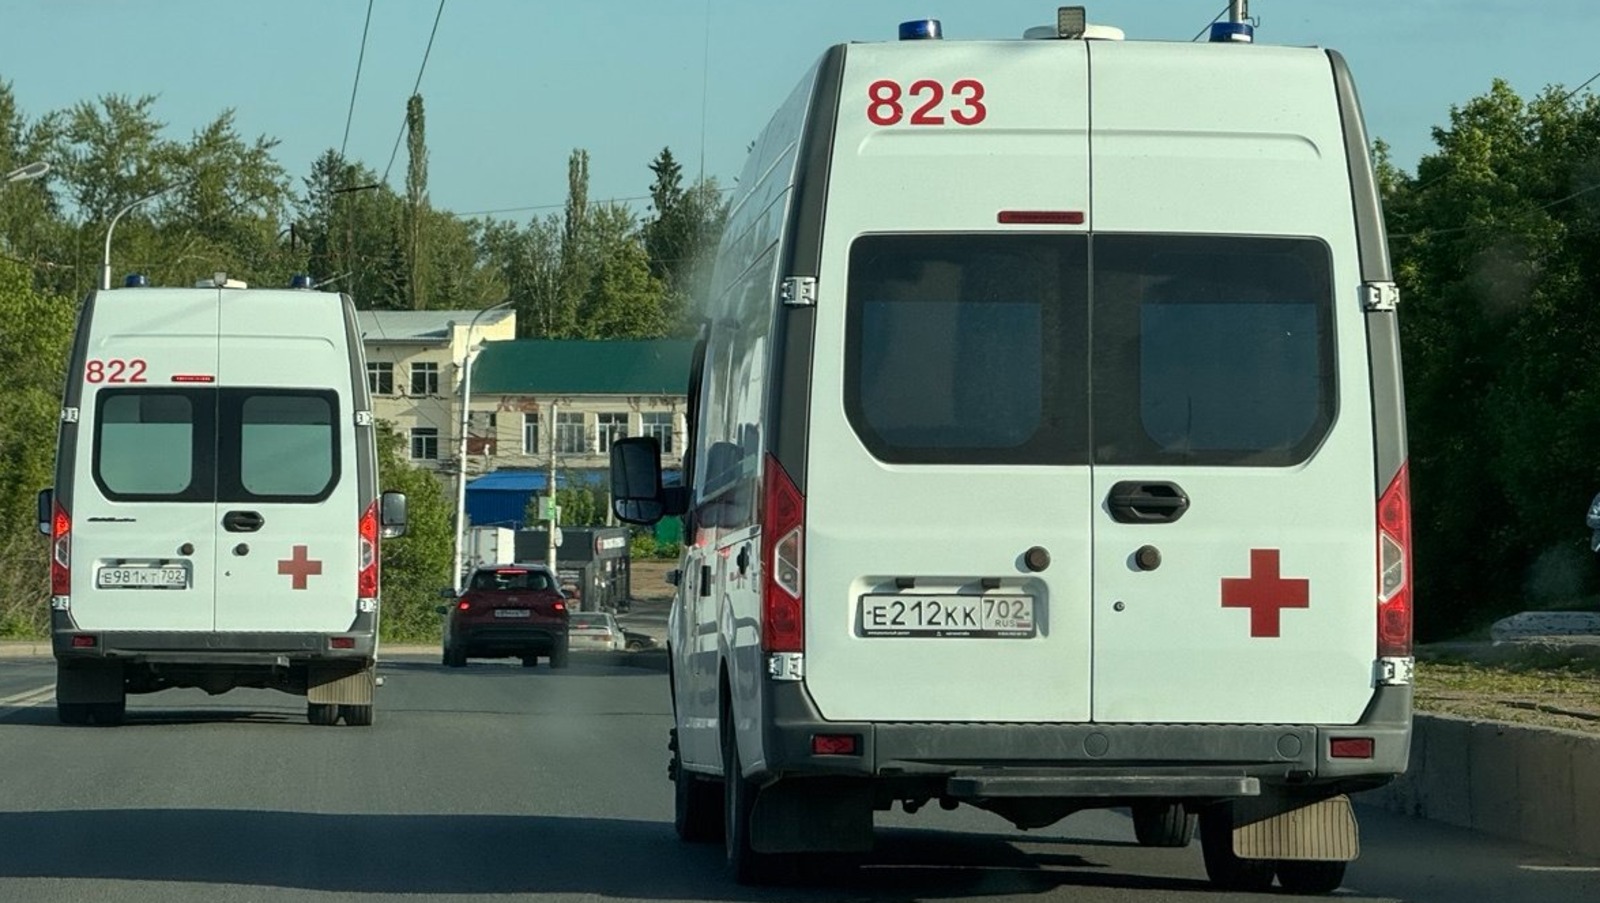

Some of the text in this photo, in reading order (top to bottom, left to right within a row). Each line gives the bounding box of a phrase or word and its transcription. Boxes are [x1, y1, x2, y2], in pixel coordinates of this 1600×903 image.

[867, 79, 987, 126] 823
[86, 359, 147, 383] 822
[161, 569, 182, 581] 702
[873, 599, 1025, 627] Е212КК 702
[994, 619, 1016, 628] RUS
